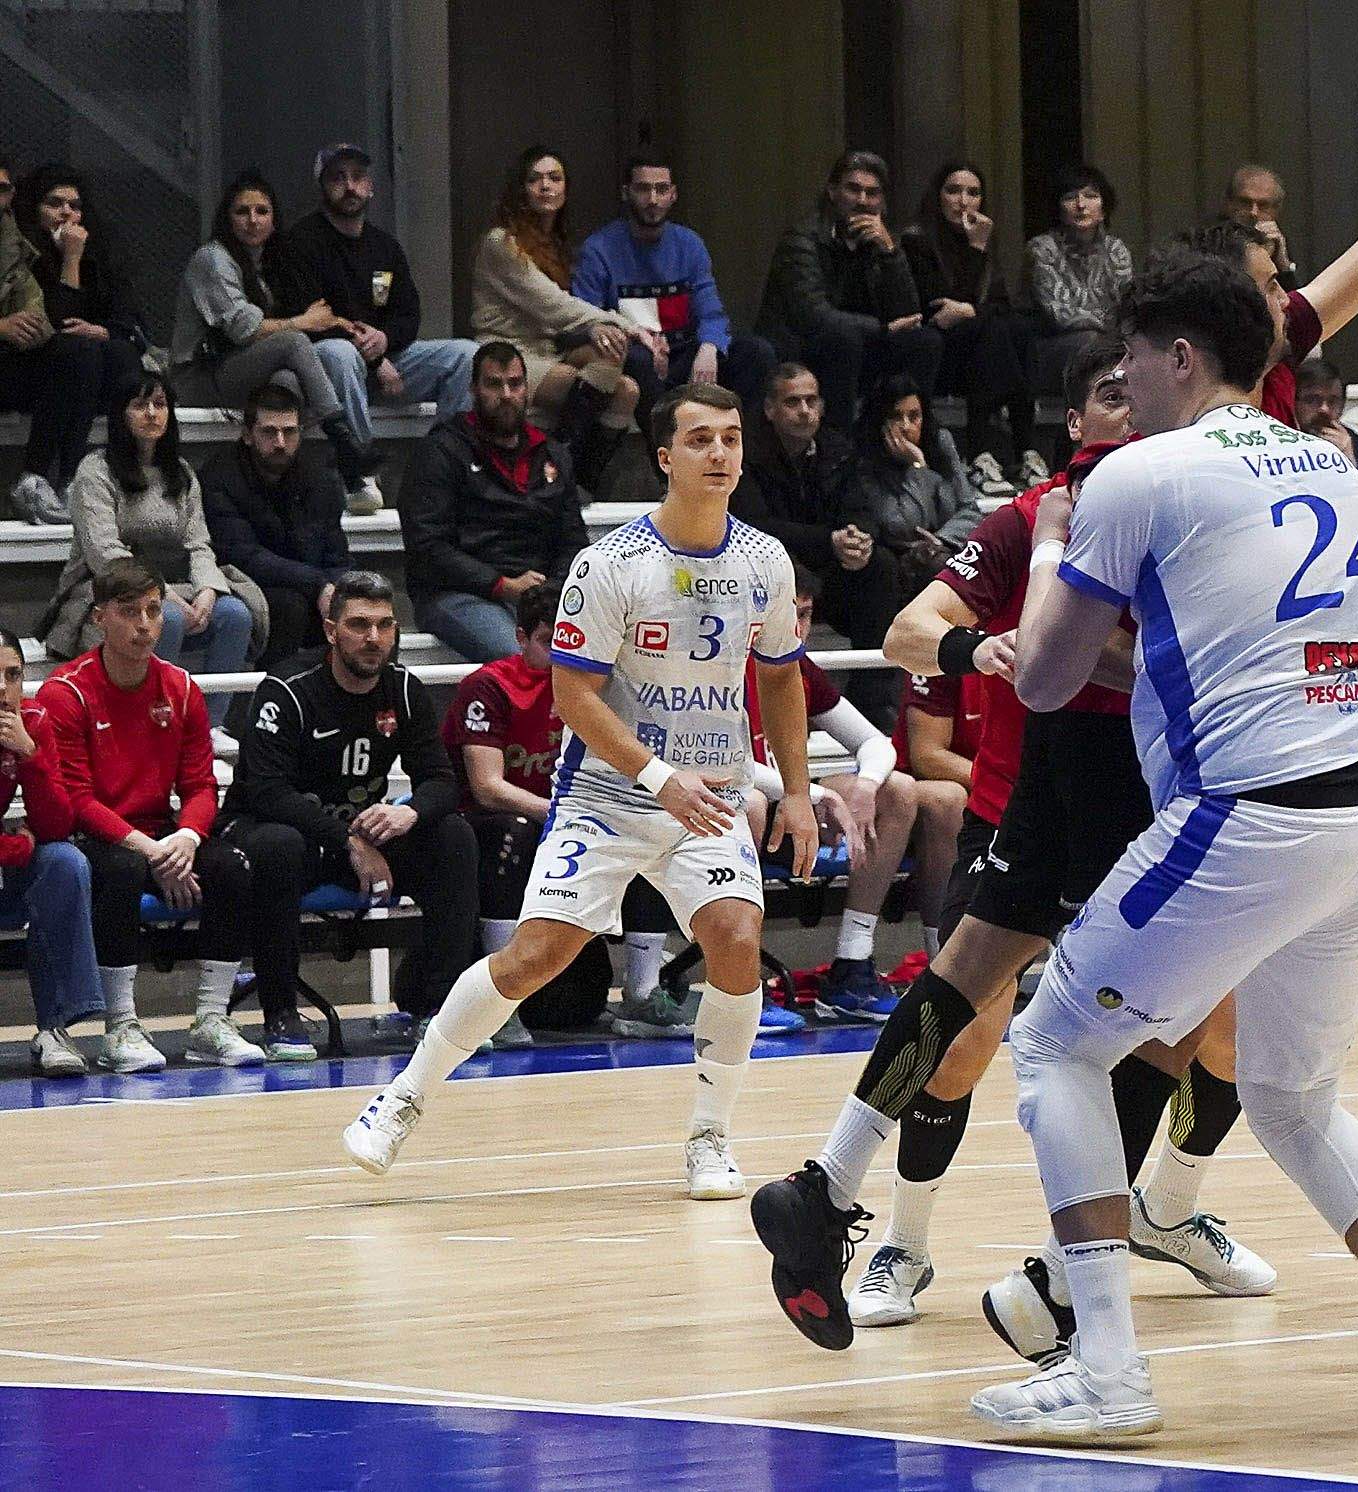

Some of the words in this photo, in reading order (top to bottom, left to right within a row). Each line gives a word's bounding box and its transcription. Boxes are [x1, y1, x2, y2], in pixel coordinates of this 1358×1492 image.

[620, 544, 653, 561] Kempa
[695, 578, 739, 596] ence
[689, 614, 725, 661] 3
[674, 733, 730, 749] XUNTA
[341, 737, 372, 777] 16
[671, 750, 692, 766] DE
[544, 840, 588, 879] 3
[539, 887, 578, 899] Kempa
[1064, 1243, 1128, 1257] Kempa
